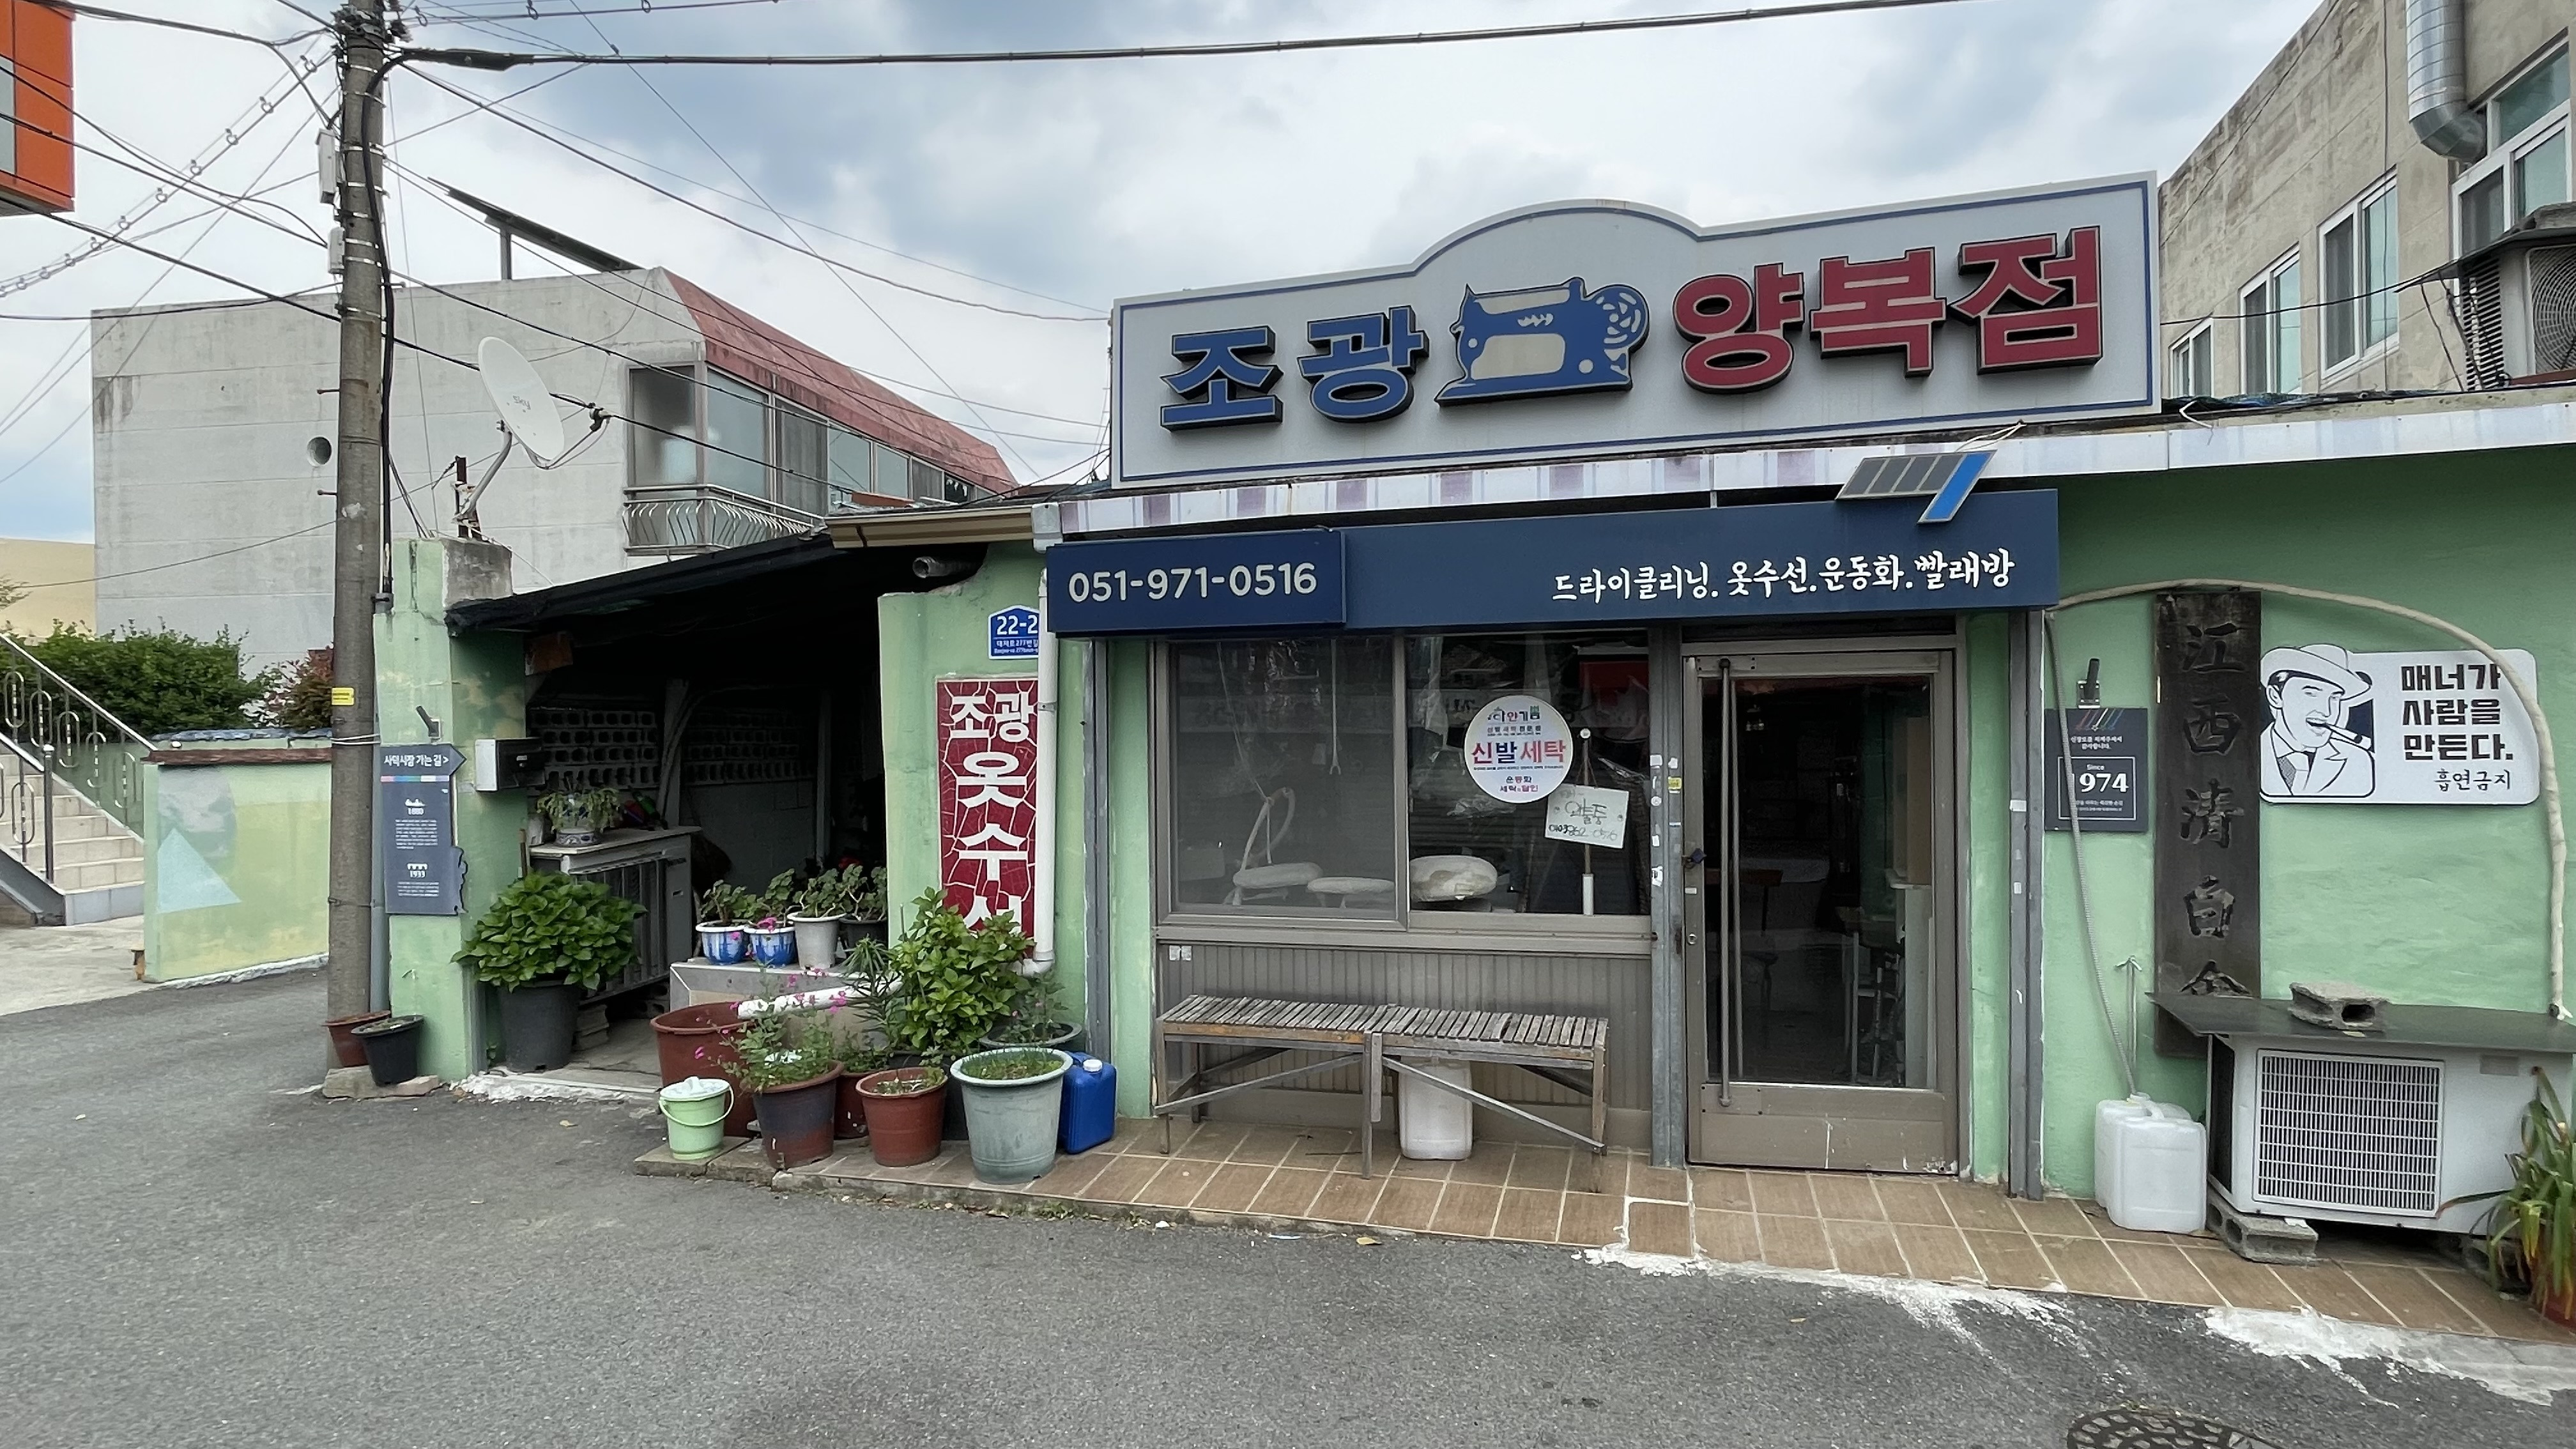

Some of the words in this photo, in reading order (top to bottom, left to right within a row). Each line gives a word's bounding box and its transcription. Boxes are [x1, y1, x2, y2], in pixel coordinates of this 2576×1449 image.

[1159, 304, 1429, 433] 조광
[1672, 224, 2103, 394] 양복점
[1068, 562, 1317, 602] 051-971-0516
[997, 615, 1038, 635] 22-2
[2401, 663, 2501, 691] 매너가
[950, 692, 1032, 743] 조광
[2402, 698, 2501, 726] 사람을
[2404, 733, 2513, 760] 만든다.
[2072, 773, 2129, 792] 974
[2434, 769, 2511, 792] 흡연금지
